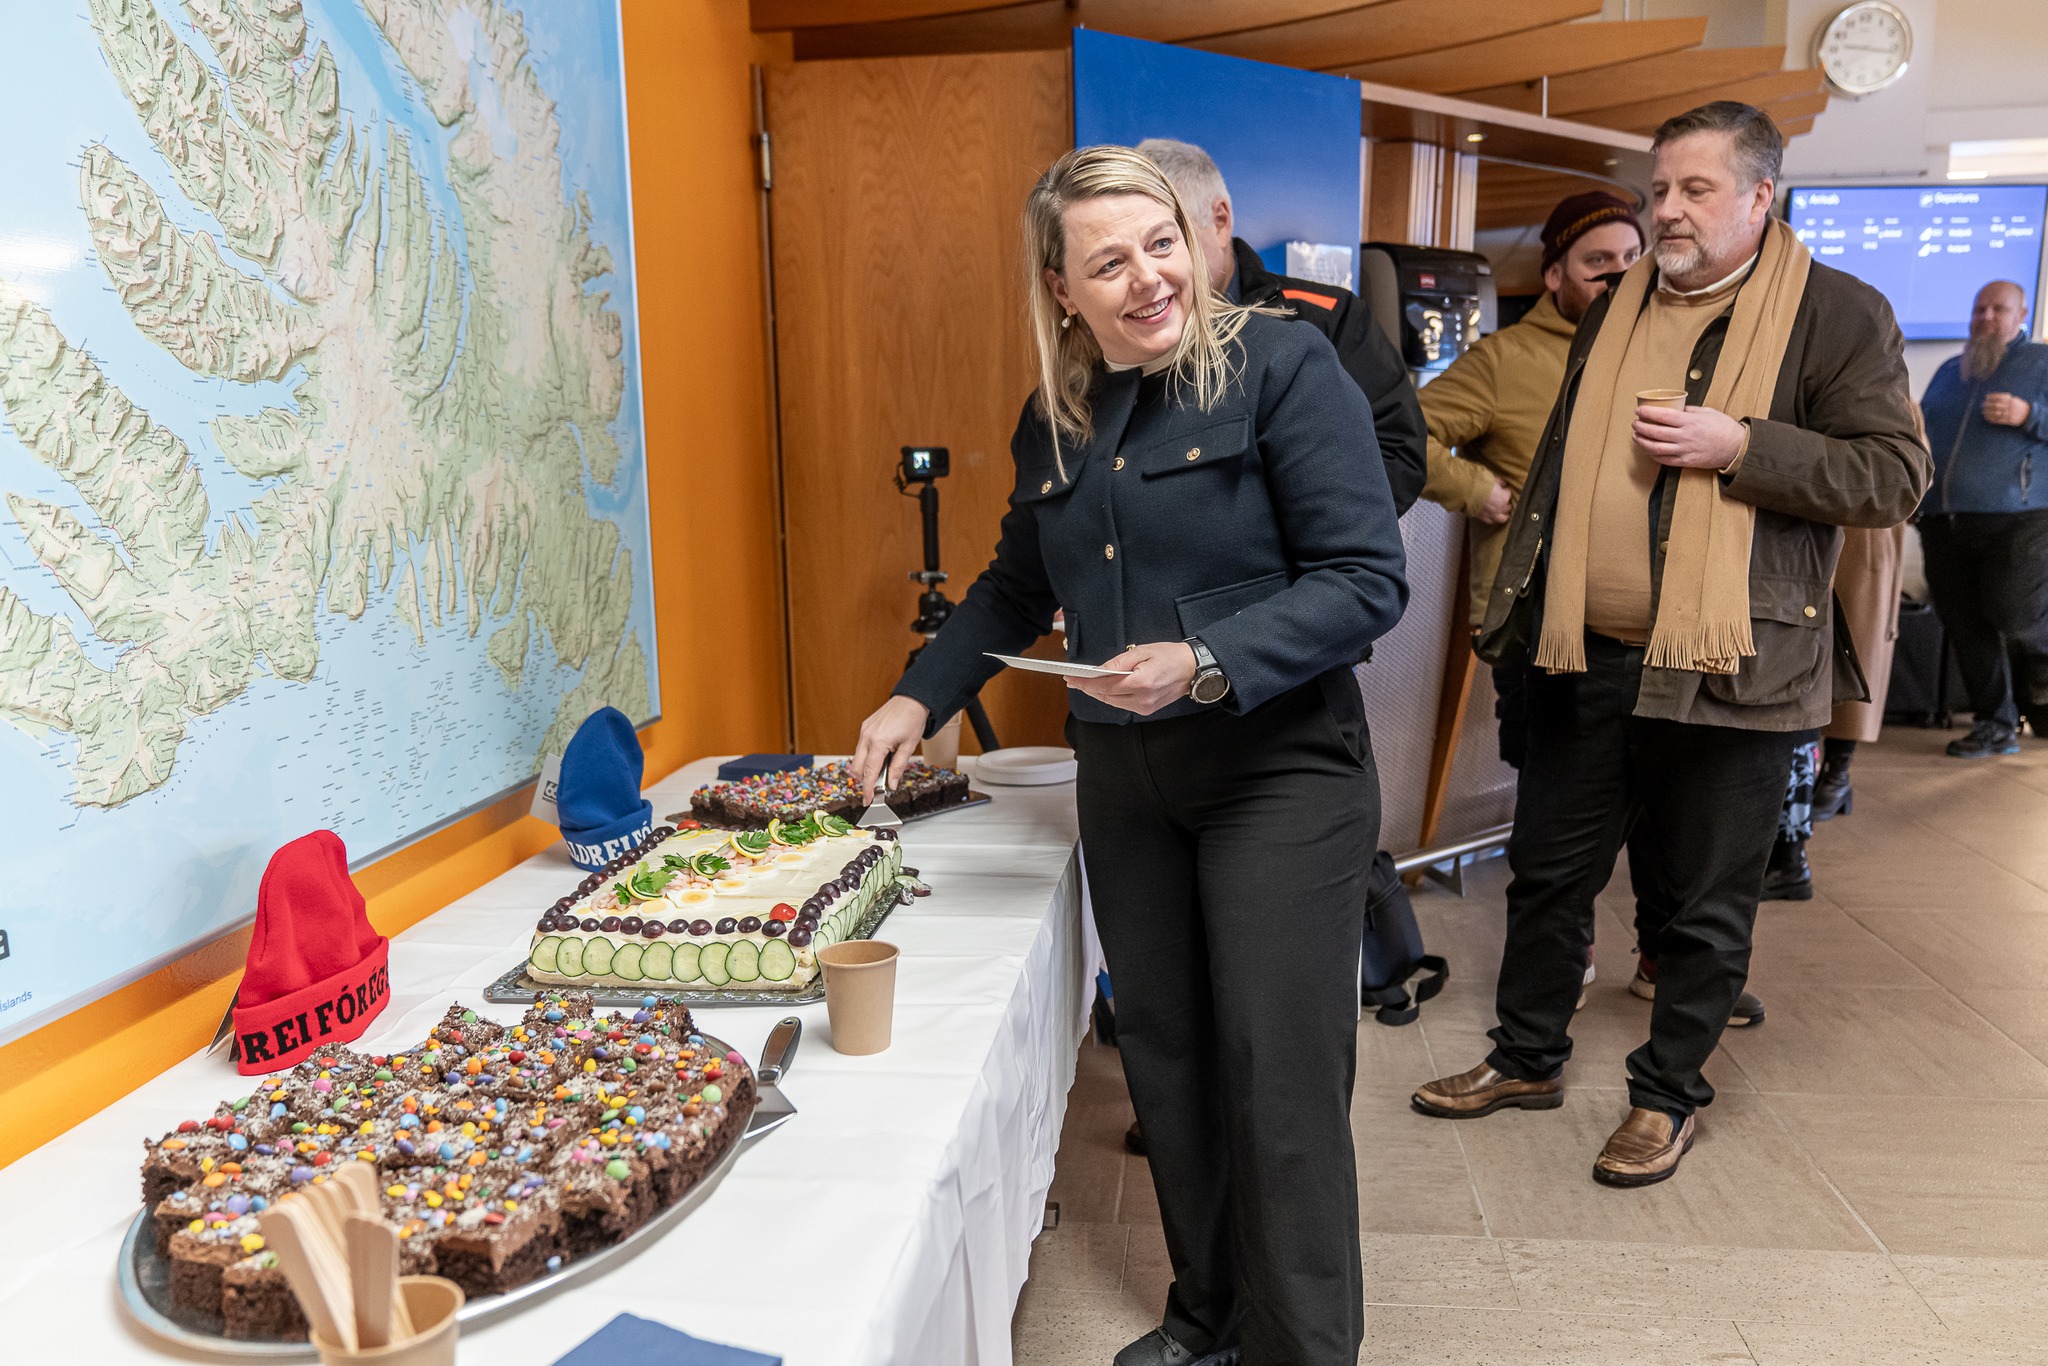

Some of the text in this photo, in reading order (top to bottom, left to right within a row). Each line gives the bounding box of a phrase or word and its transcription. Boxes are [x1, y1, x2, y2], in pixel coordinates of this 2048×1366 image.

[567, 820, 653, 866] LDREI FÓ
[240, 1012, 312, 1064] REI
